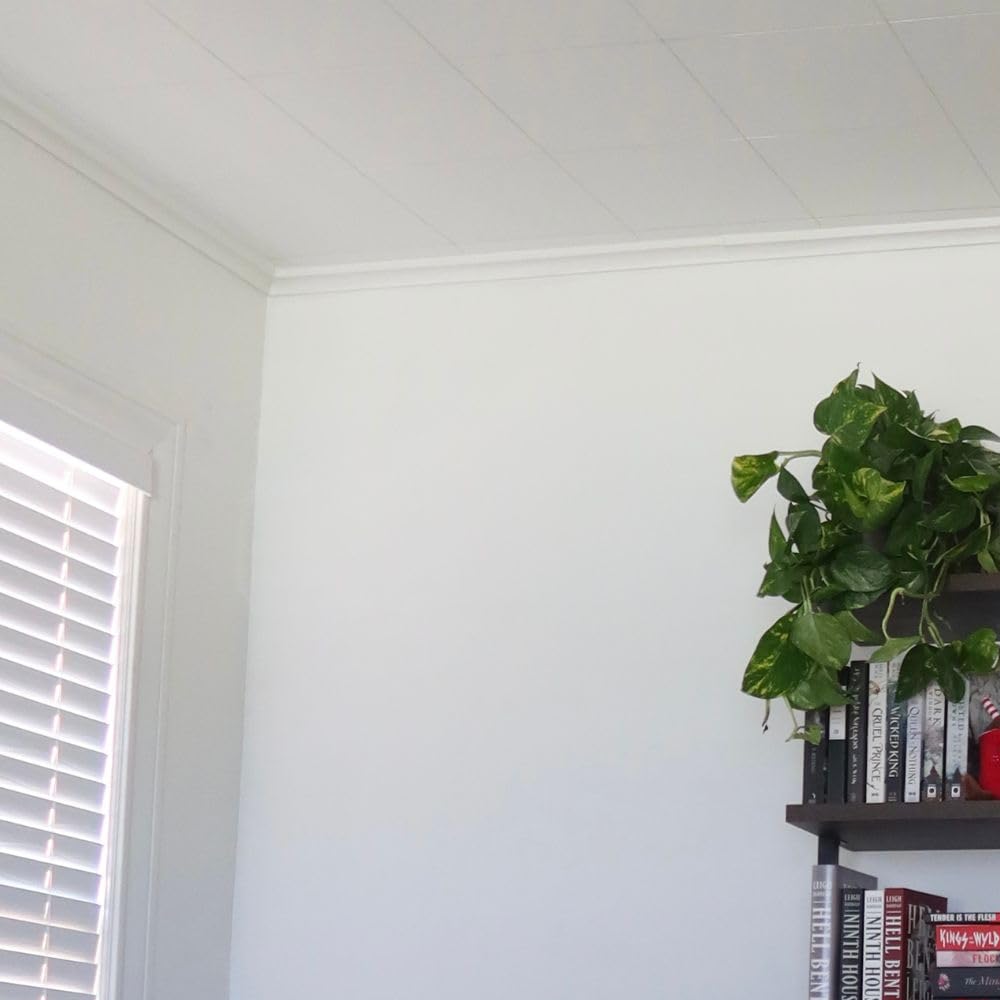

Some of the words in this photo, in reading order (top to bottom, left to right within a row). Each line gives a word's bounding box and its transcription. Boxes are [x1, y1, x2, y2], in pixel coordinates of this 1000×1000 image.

[872, 707, 883, 743] CRUEL
[888, 706, 901, 749] WICKED
[870, 745, 882, 782] PRINCE
[887, 750, 900, 778] KING
[812, 908, 832, 953] HELL
[843, 914, 860, 960] NINTH
[884, 916, 902, 955] HELL
[930, 913, 955, 922] TENDER
[964, 913, 976, 921] THE
[977, 913, 996, 922] FLESH
[865, 916, 882, 965] NINTH
[973, 930, 1000, 948] WYLD
[884, 959, 901, 999] BENT
